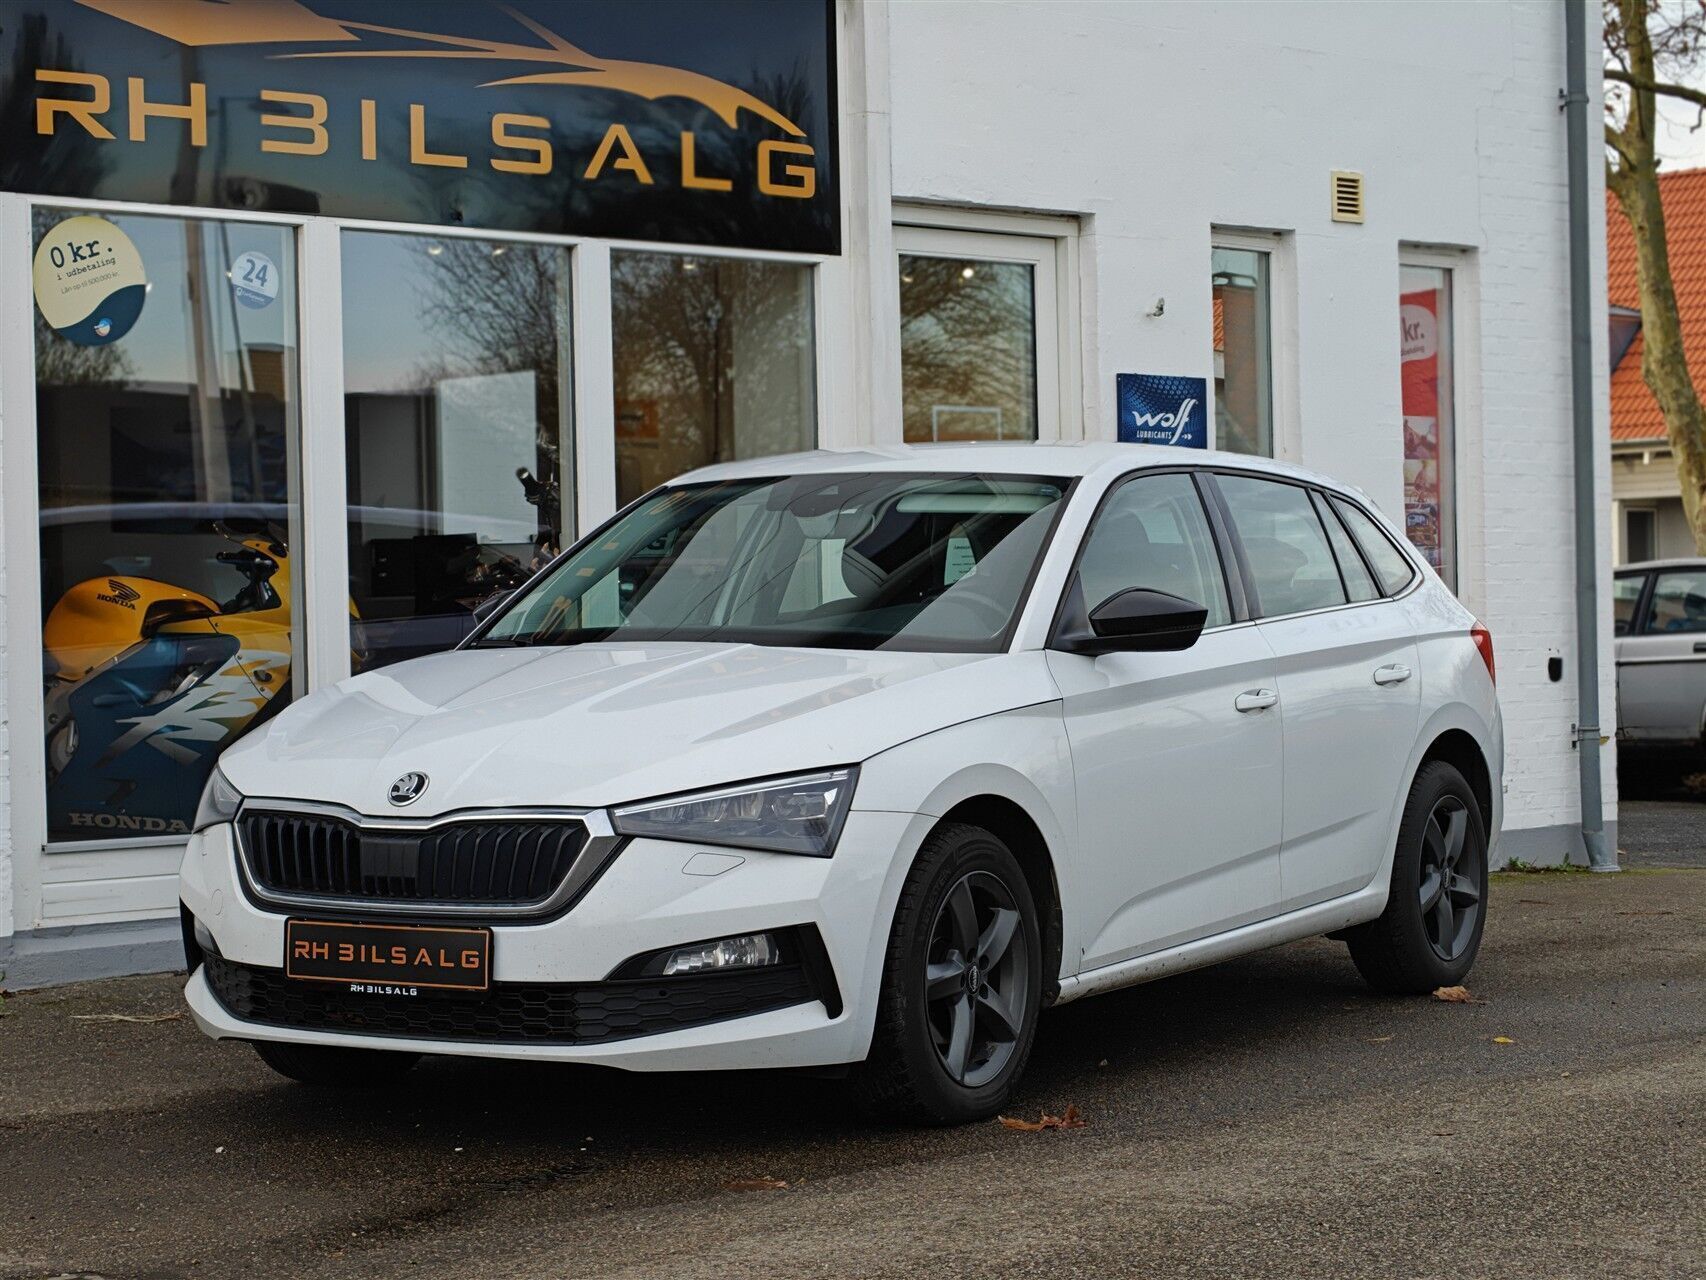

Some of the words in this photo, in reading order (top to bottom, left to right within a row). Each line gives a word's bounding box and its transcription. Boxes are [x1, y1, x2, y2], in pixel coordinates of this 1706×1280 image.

[35, 68, 208, 147] RH
[67, 240, 113, 263] kr.
[65, 257, 117, 278] udbetaling
[242, 258, 268, 287] 24
[1401, 316, 1425, 343] kr.
[1136, 430, 1172, 440] LUBRICANTS
[96, 592, 137, 611] HONDA
[68, 812, 191, 833] HONDA
[294, 940, 329, 960] RH
[350, 984, 364, 993] RH
